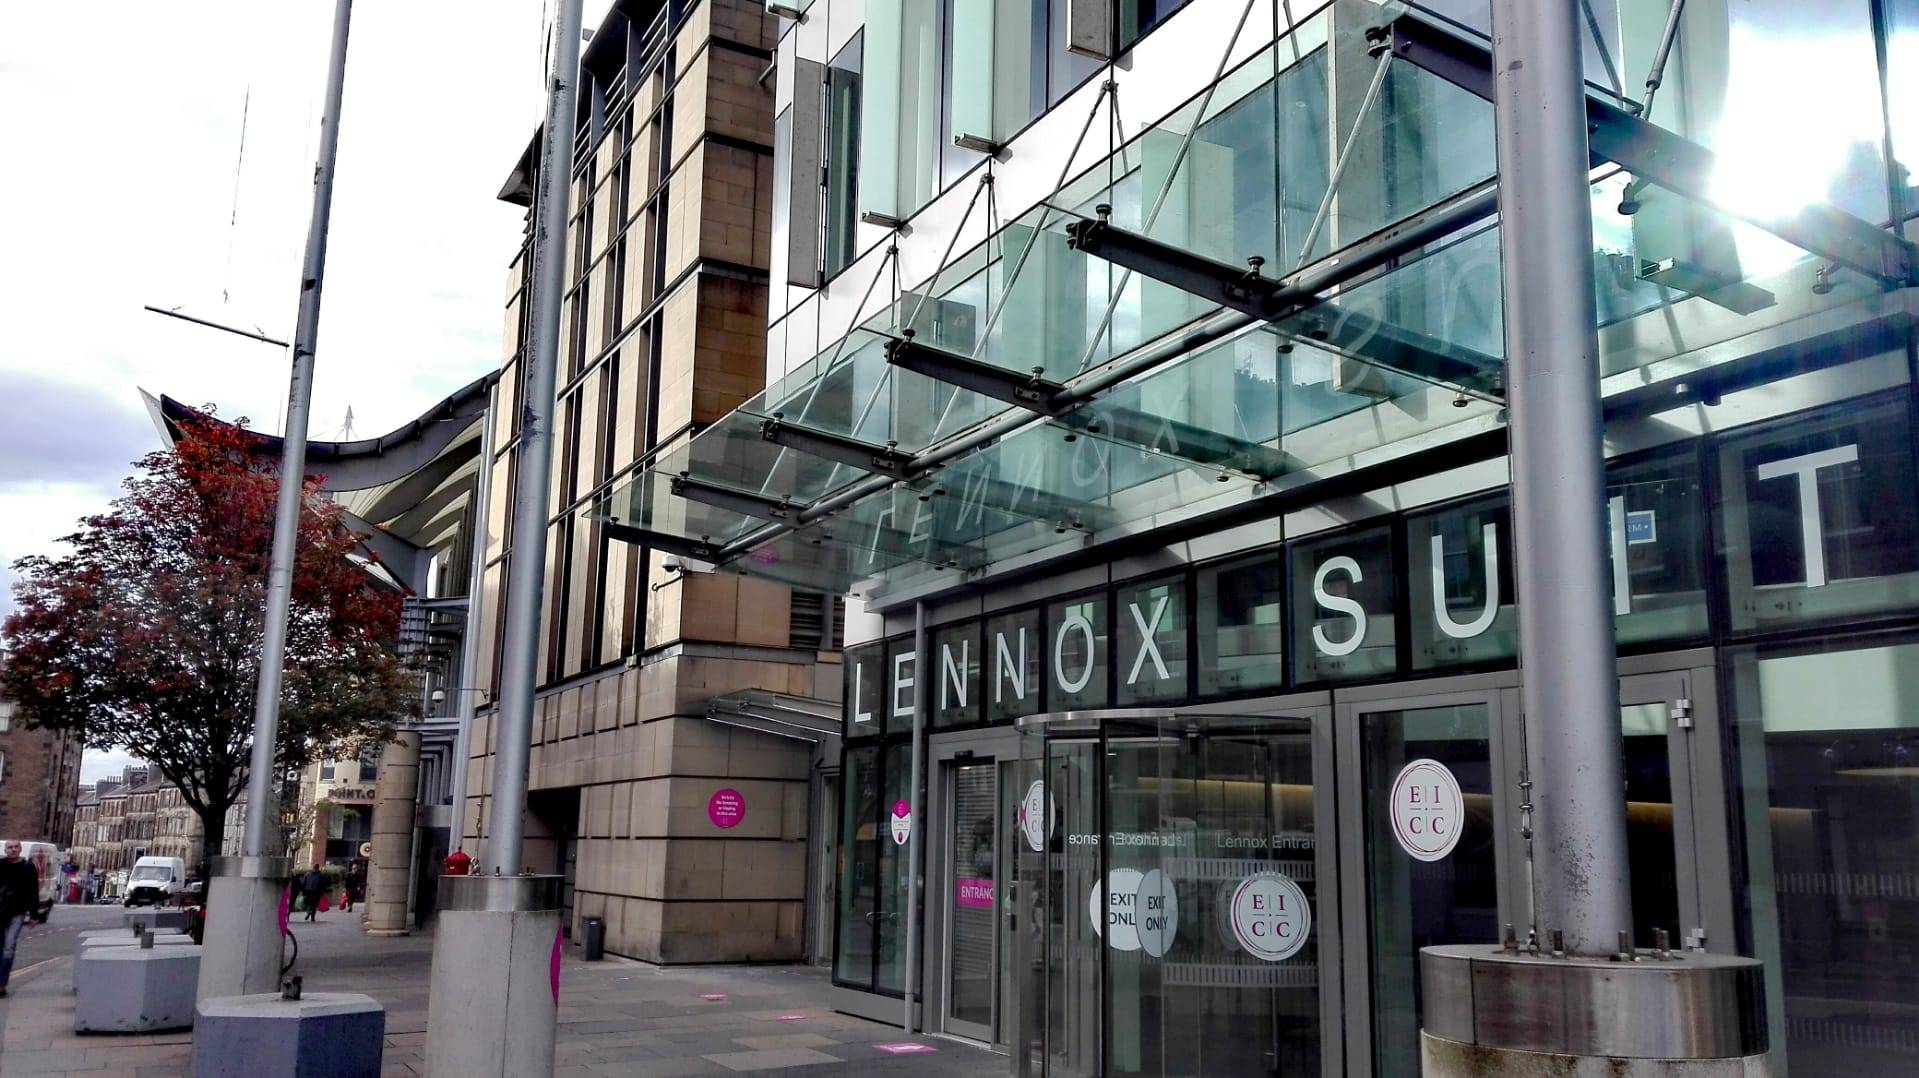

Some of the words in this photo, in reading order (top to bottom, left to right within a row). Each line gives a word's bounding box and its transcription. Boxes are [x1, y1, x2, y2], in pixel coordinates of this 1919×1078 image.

[855, 597, 1170, 722] LENNOX
[1217, 834, 1268, 849] Lennox
[1111, 892, 1137, 906] EXIT
[1147, 896, 1166, 910] EXIT
[1146, 916, 1168, 931] ONLY
